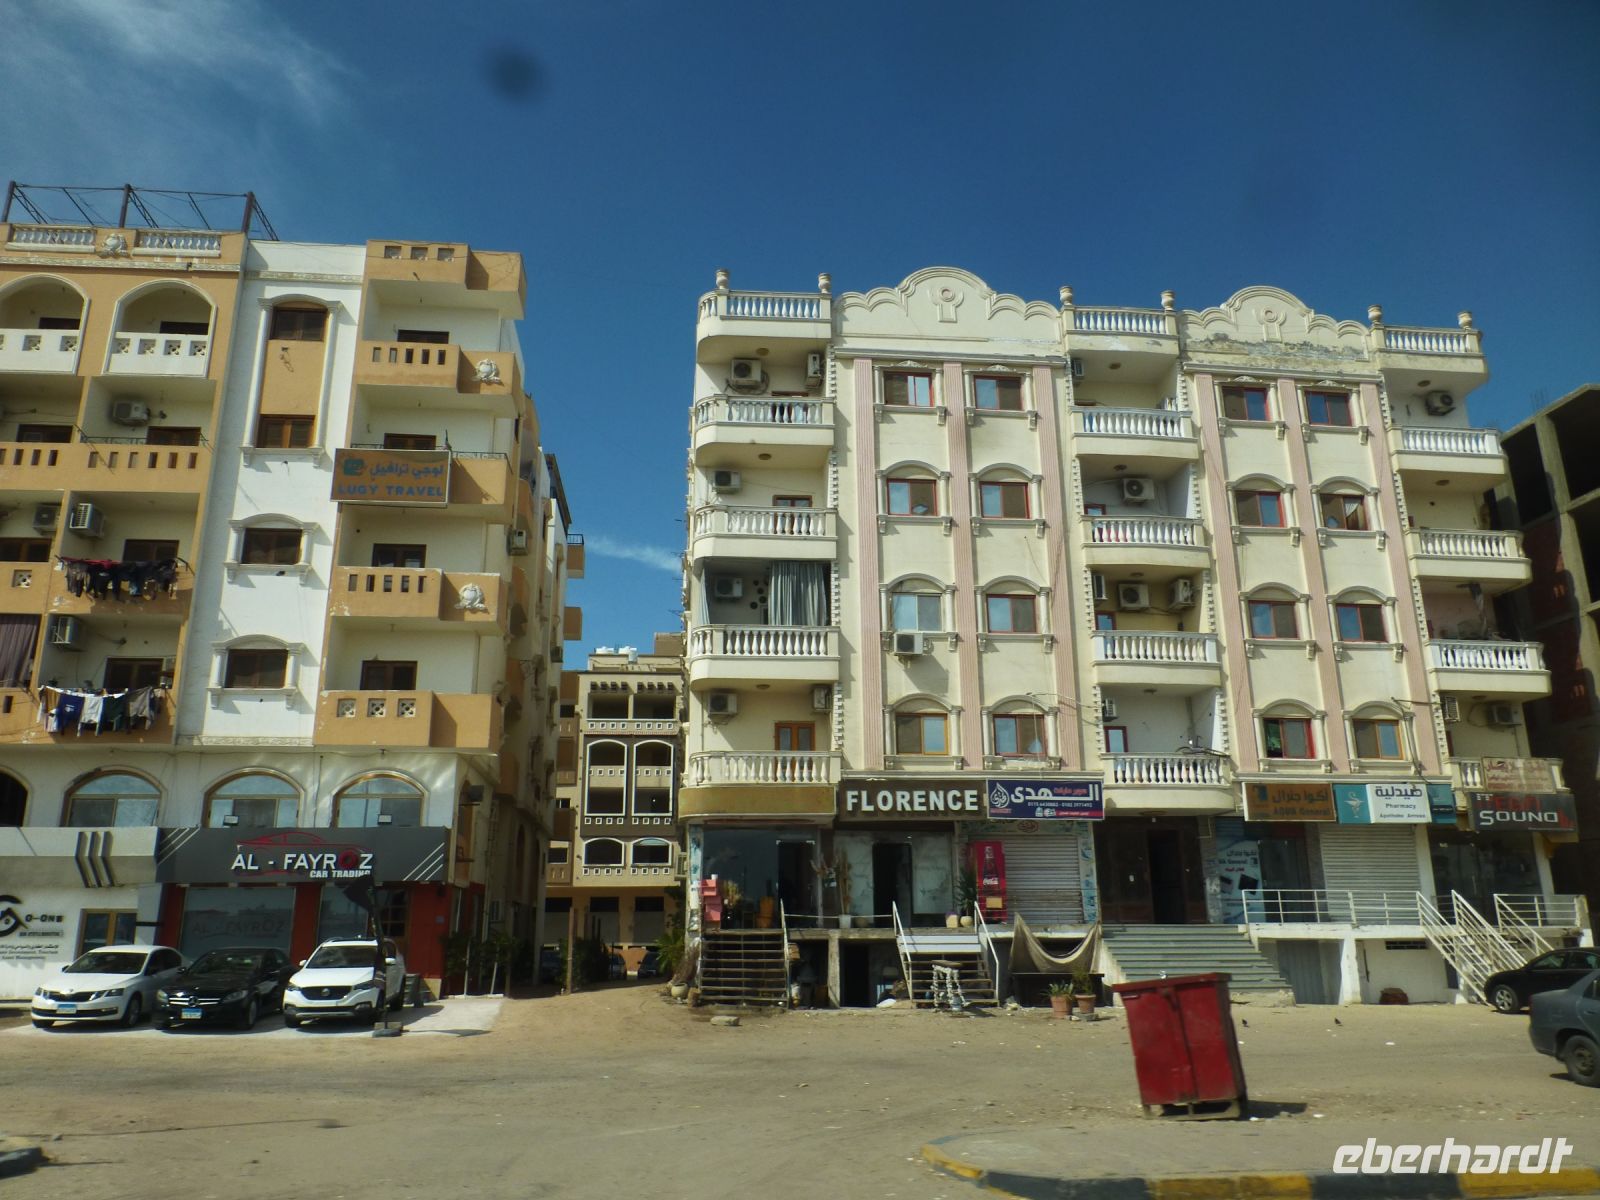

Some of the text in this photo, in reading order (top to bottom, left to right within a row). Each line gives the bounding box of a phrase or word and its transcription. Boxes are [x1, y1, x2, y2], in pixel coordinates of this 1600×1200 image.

[386, 485, 443, 497] TRAVEL
[846, 789, 978, 812] FLORENCE
[1480, 810, 1559, 826] SOUND
[231, 853, 259, 870] AL
[283, 850, 373, 870] FAYROZ
[309, 869, 328, 878] CAR
